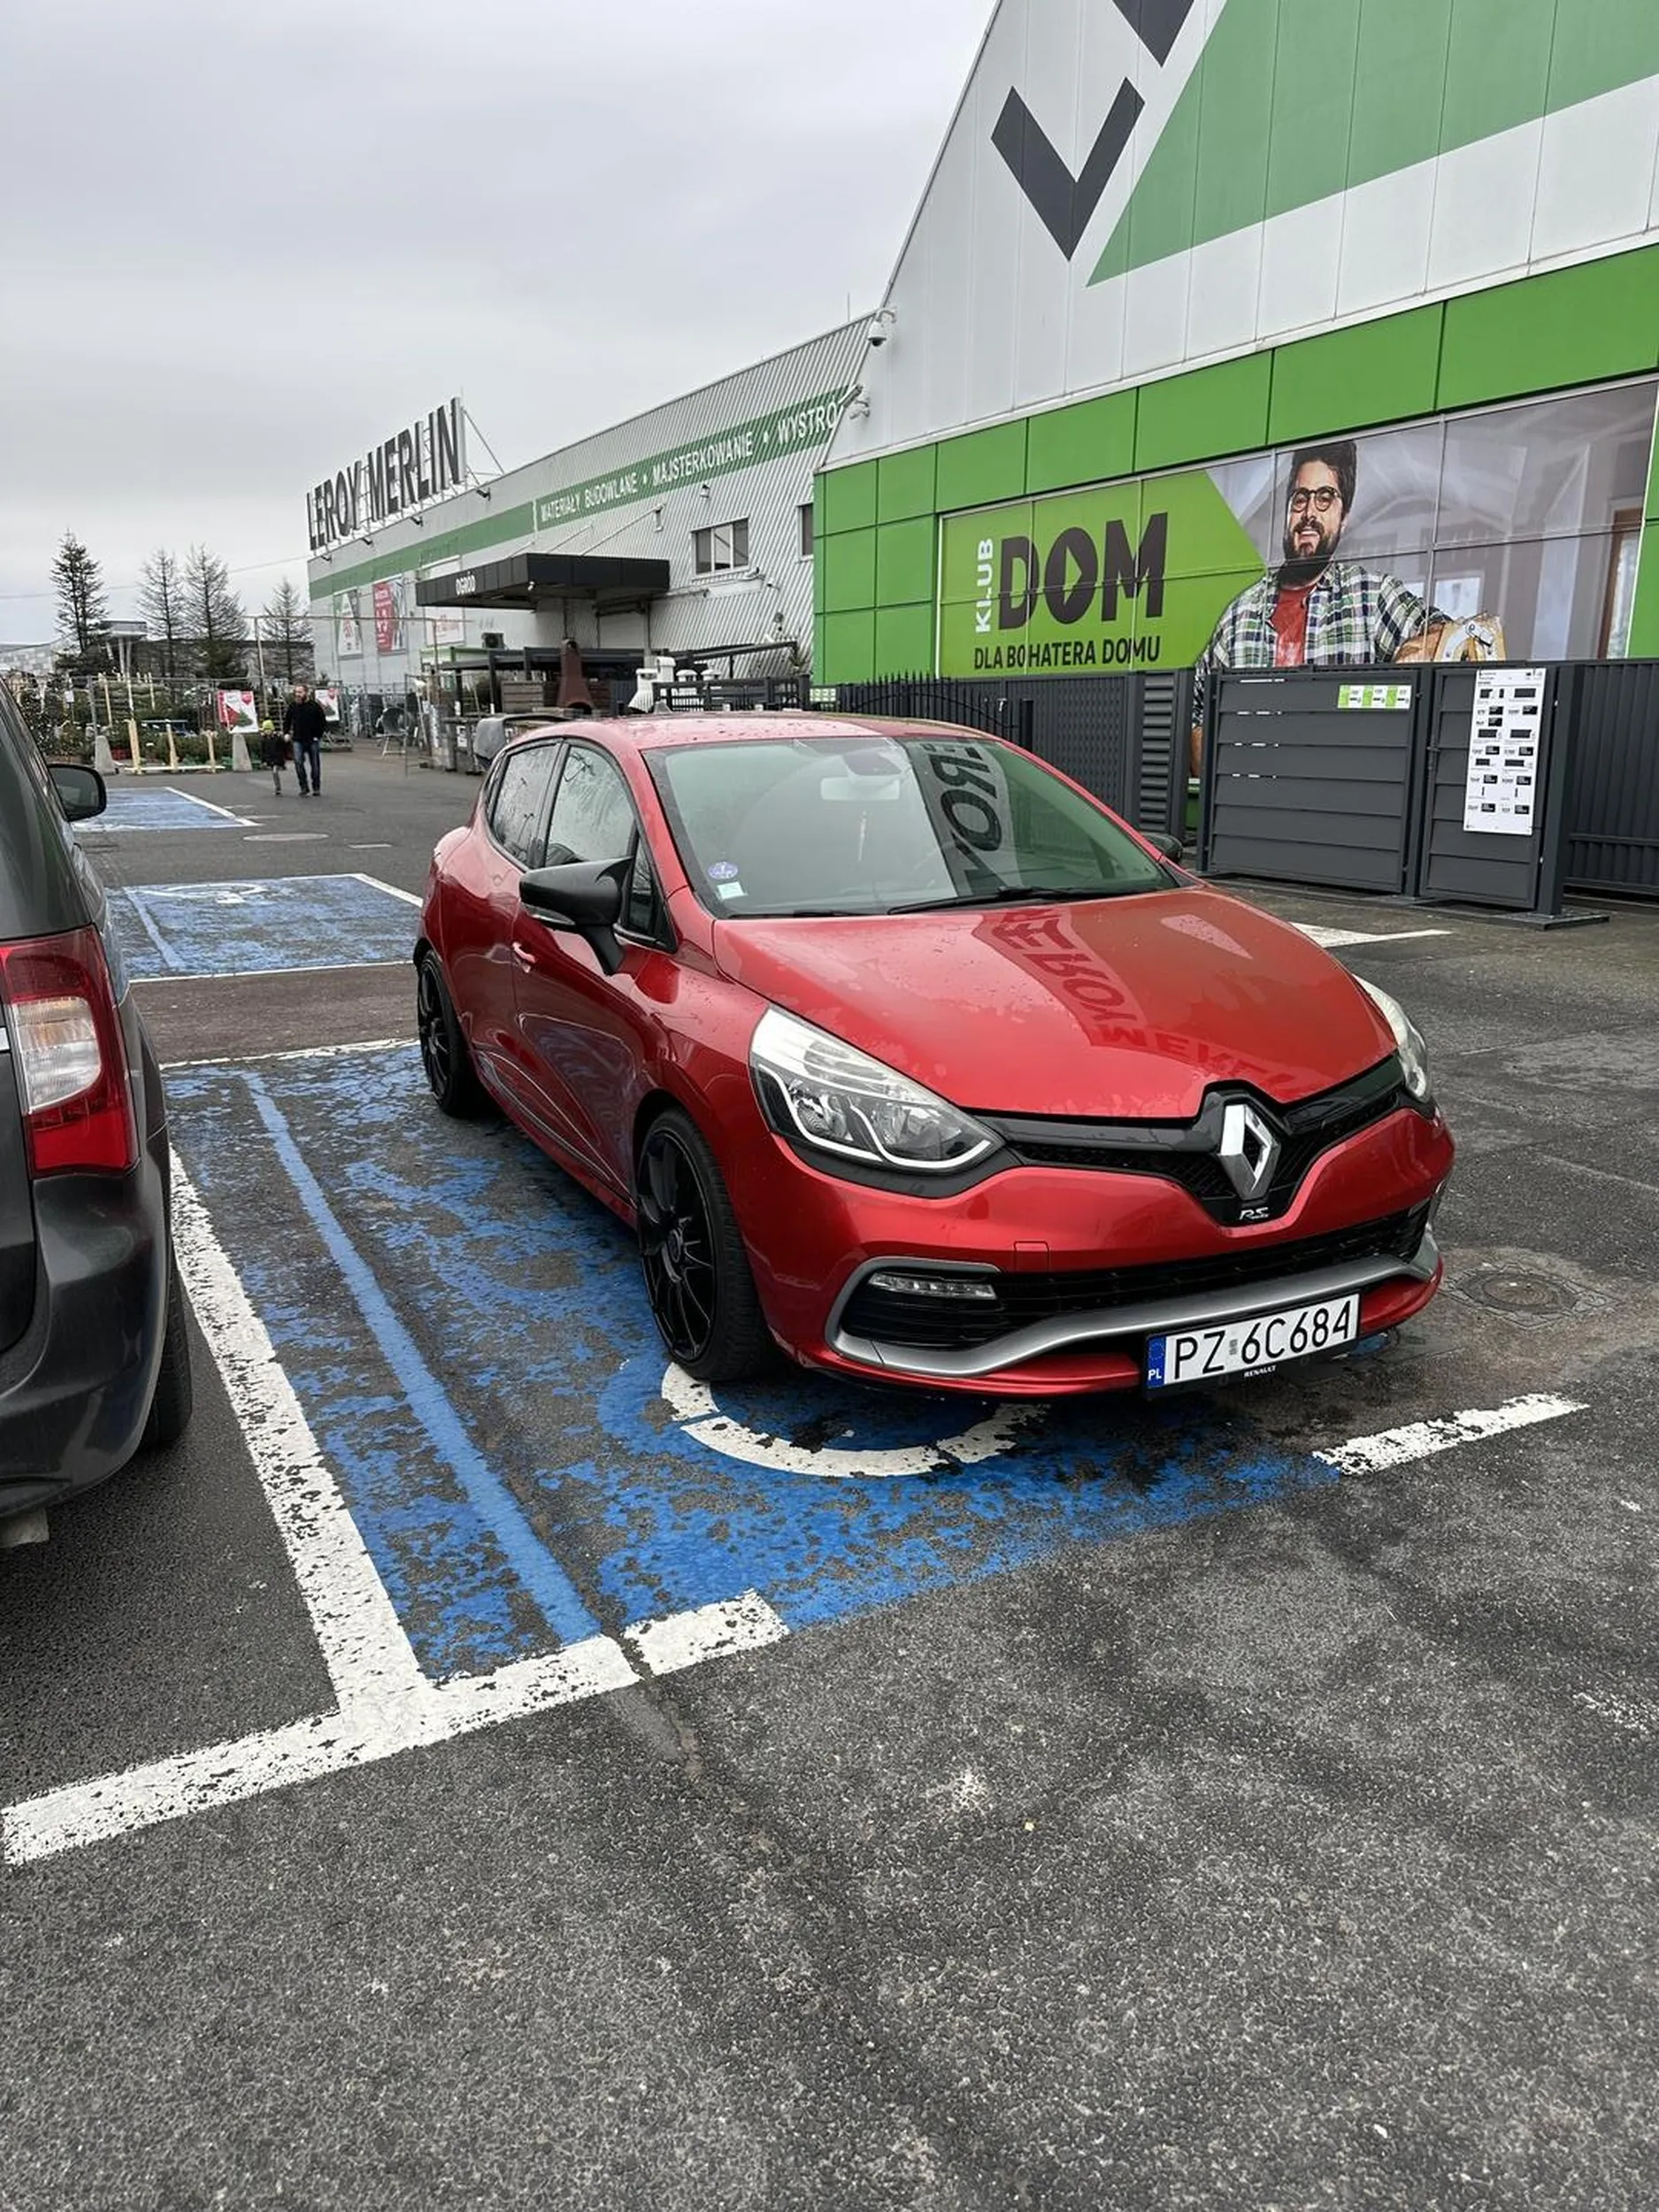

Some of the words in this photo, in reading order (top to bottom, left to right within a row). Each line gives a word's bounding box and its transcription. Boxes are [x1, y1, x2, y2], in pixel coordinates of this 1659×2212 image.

[307, 460, 361, 550] LEROY
[367, 396, 461, 522] MERLIN
[584, 472, 637, 508] BUDOWLANE
[652, 431, 753, 486] MAJSTERKOWANIE
[976, 538, 994, 633] KLUB
[999, 512, 1168, 630] DOM
[974, 647, 1003, 670] DLA
[1007, 640, 1096, 667] BOHATERA
[1102, 635, 1161, 664] DOMU
[1148, 1369, 1163, 1380] PL
[1173, 1330, 1226, 1379] PZ
[1241, 1300, 1351, 1364] 6C684
[1244, 1364, 1277, 1378] RENAULT
